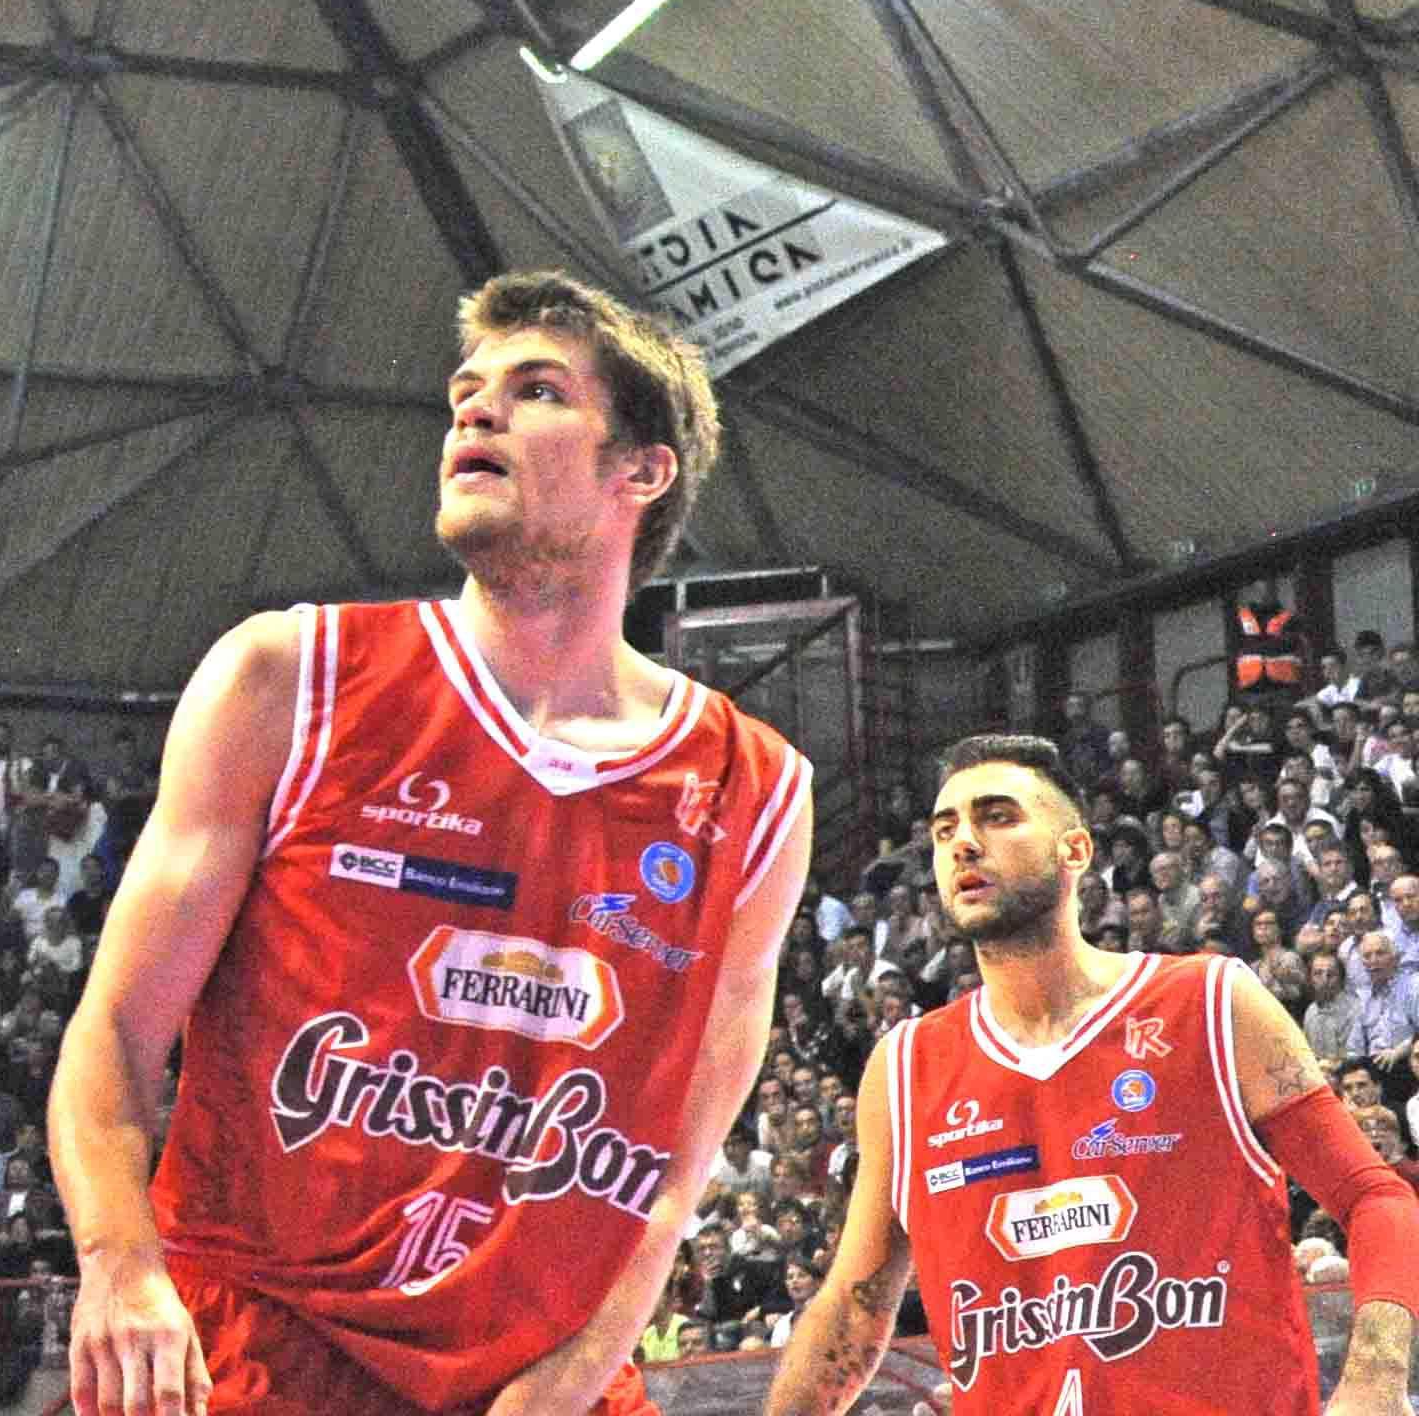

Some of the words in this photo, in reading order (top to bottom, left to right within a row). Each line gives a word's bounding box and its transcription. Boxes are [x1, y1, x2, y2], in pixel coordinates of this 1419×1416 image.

[440, 967, 591, 1023] FERRARINI
[269, 1011, 670, 1224] GrissinBon
[379, 1190, 496, 1297] 15
